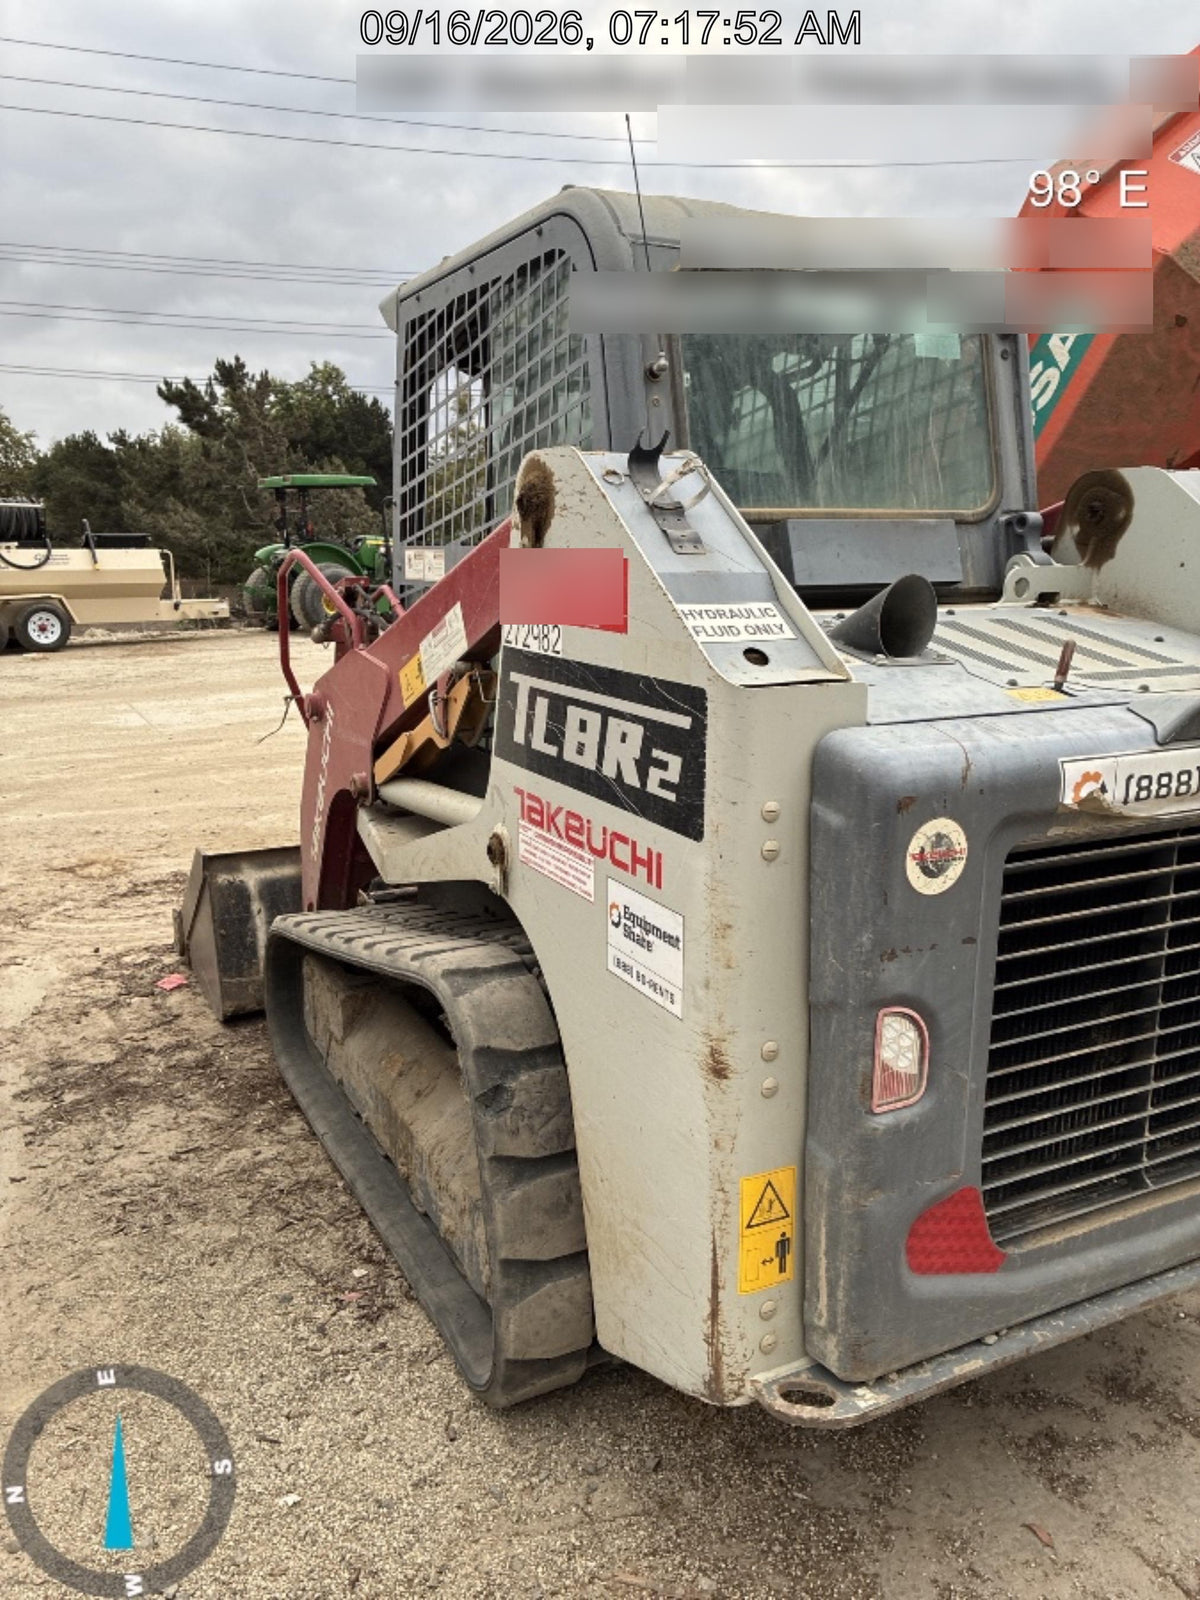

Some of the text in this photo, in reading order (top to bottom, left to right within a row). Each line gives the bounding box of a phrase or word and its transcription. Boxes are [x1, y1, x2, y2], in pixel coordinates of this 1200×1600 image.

[680, 607, 777, 621] HYDRAULIC
[691, 623, 785, 638] FLUID ONLY
[622, 922, 653, 953] Share
[623, 904, 682, 951] Equipment
